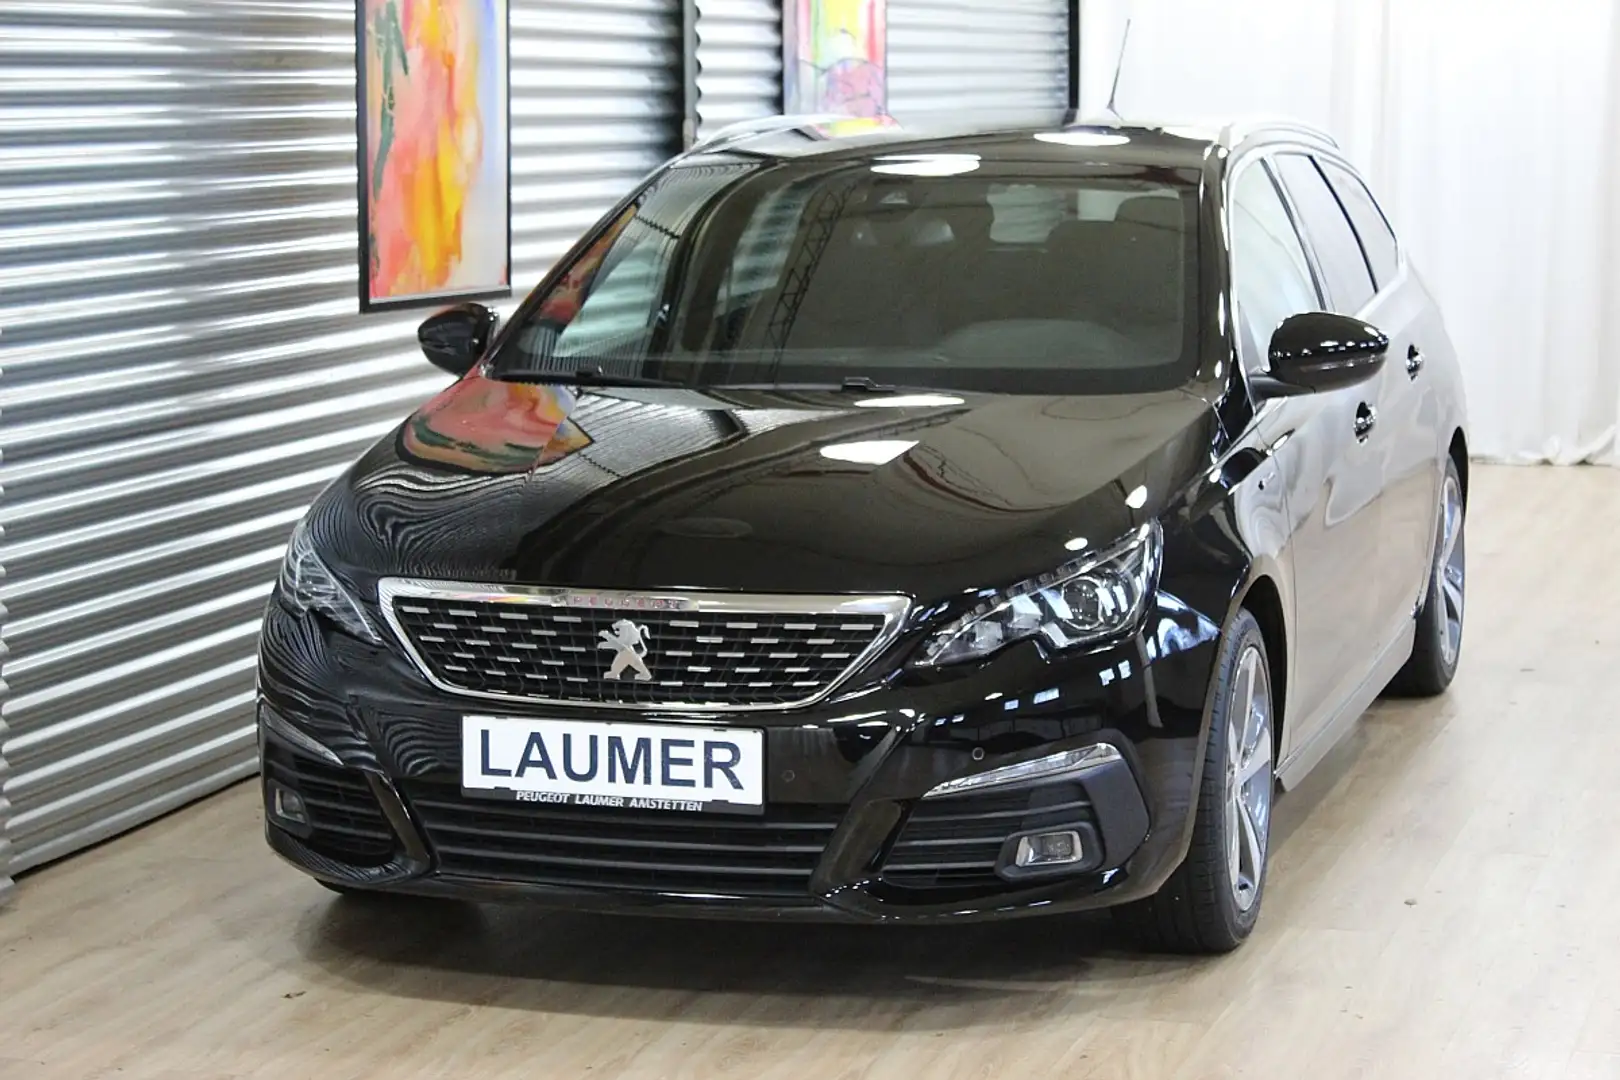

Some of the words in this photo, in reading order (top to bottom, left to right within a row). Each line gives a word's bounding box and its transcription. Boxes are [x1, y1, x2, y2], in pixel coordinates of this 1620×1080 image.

[480, 729, 744, 790] LAUMER
[516, 791, 570, 804] PEUGEOT
[575, 794, 624, 807] LAUMER
[629, 797, 702, 811] AMSTETTEN
